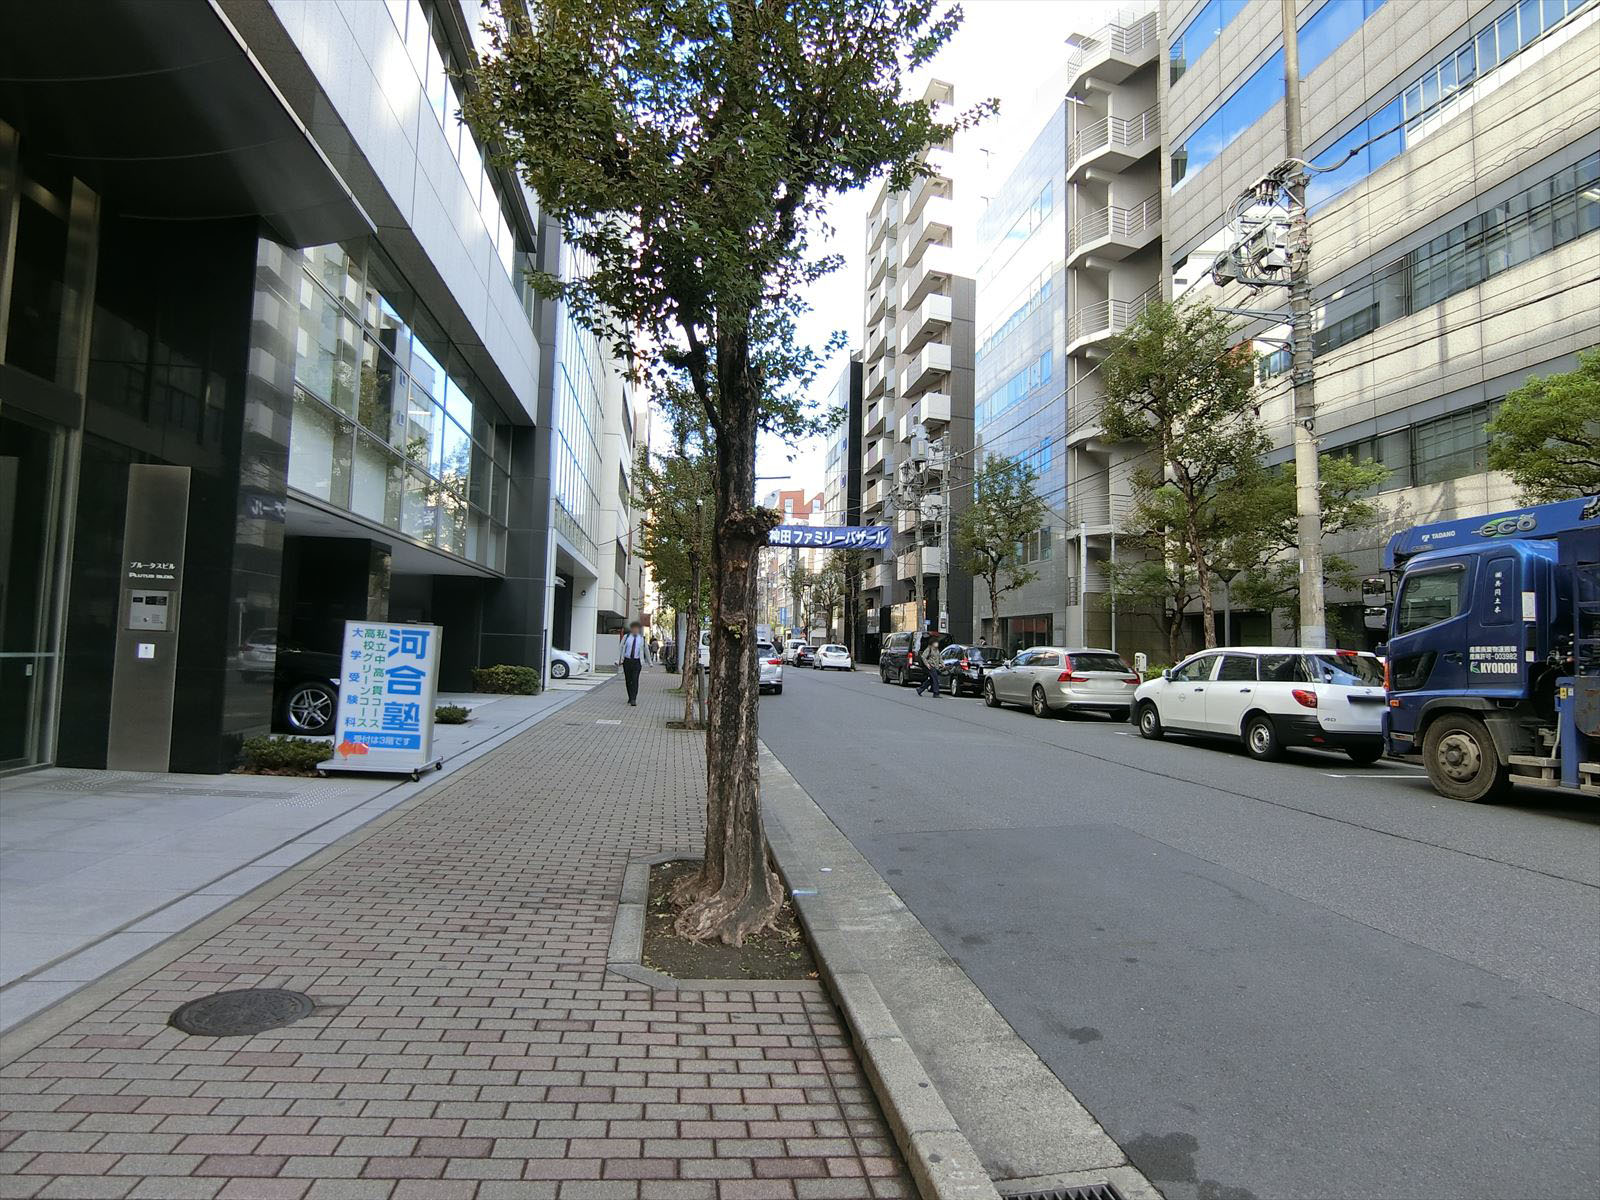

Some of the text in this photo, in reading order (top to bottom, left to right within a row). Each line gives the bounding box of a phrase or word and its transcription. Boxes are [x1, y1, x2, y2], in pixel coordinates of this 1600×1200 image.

[768, 529, 887, 545] 神田ファミリーバザール
[1431, 530, 1456, 540] TADANO
[1479, 518, 1537, 537] eco
[344, 627, 363, 727] 大学受験科
[357, 628, 377, 728] 高校グリーンコース
[369, 628, 388, 728] 私立中高一貫コース
[381, 629, 430, 732] 河合塾
[1480, 662, 1518, 674] KYODOH
